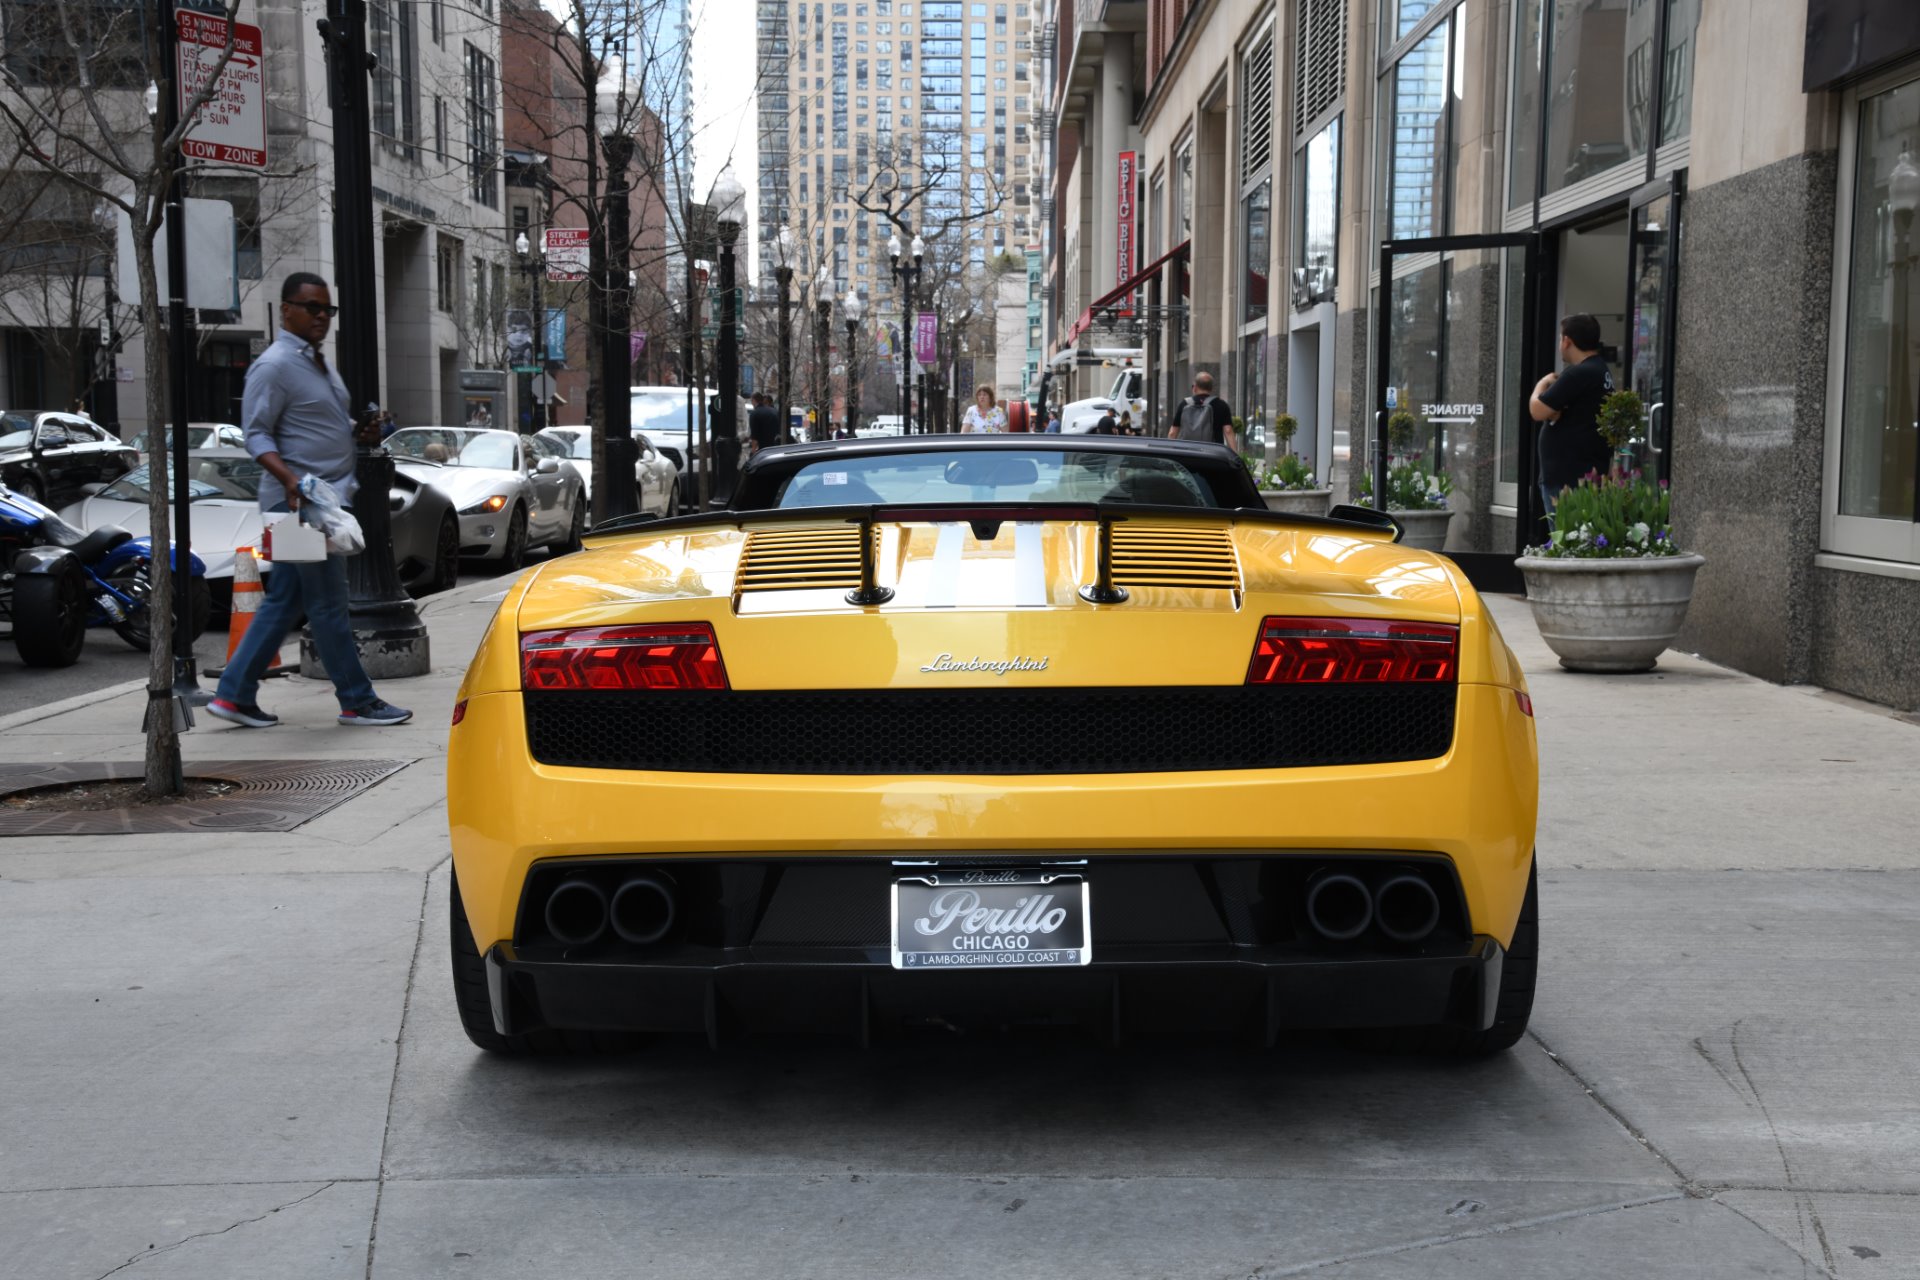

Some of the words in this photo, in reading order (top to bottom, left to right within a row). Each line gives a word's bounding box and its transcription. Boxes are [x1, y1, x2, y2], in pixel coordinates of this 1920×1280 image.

[181, 14, 191, 27] 15
[193, 17, 227, 34] MINUTE
[182, 28, 226, 46] STANDING
[234, 39, 254, 52] ONE
[219, 78, 225, 89] 8
[227, 80, 241, 92] PM
[229, 68, 260, 84] LIGHTS
[220, 102, 226, 113] 6
[227, 103, 241, 116] PM
[209, 112, 229, 125] SUN
[187, 140, 217, 158] TOW
[223, 146, 259, 165] ZONE
[1119, 158, 1130, 218] EPIC
[549, 231, 579, 239] STREET
[1119, 223, 1129, 310] BURGR
[920, 652, 1048, 676] Lamborghini
[914, 889, 1067, 936] Perillo
[952, 935, 1030, 950] CHICAGO
[922, 953, 994, 965] LAMBORGHINI
[997, 952, 1025, 963] GOLD
[1028, 952, 1060, 963] COAST
